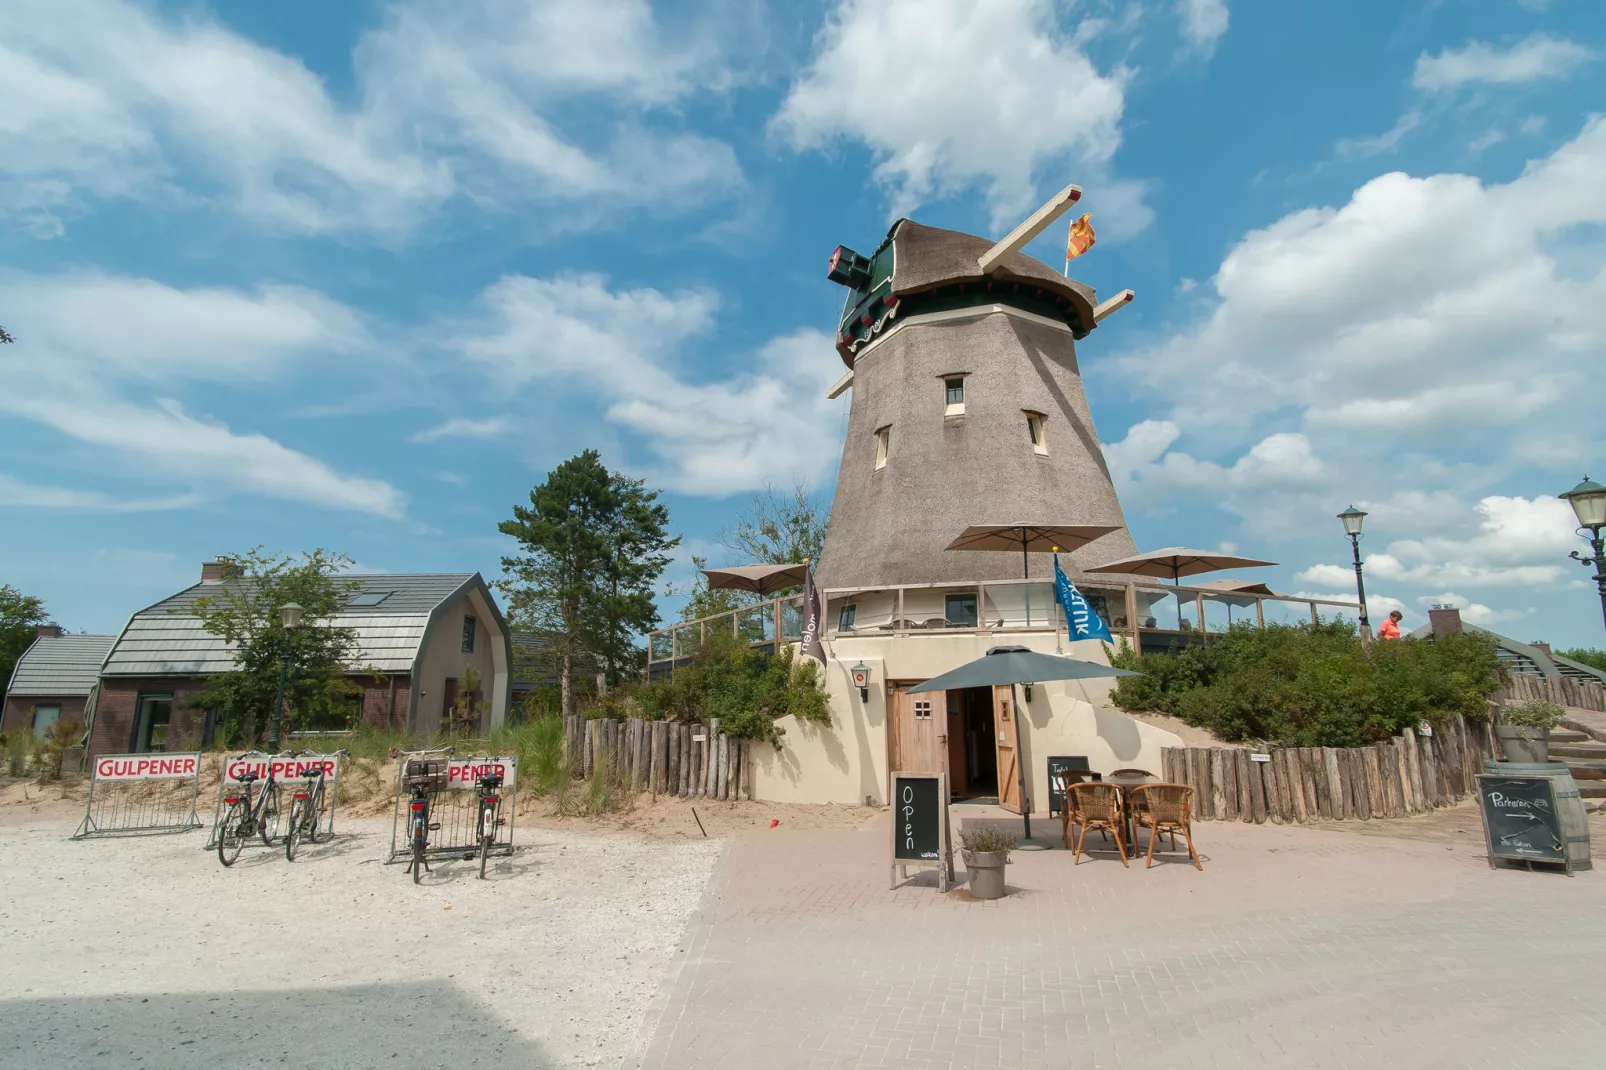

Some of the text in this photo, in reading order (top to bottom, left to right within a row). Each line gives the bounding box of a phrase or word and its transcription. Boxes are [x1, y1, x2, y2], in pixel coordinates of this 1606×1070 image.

[98, 758, 196, 777] GULPENER
[448, 764, 505, 782] PENER
[1487, 792, 1532, 808] Parkeren
